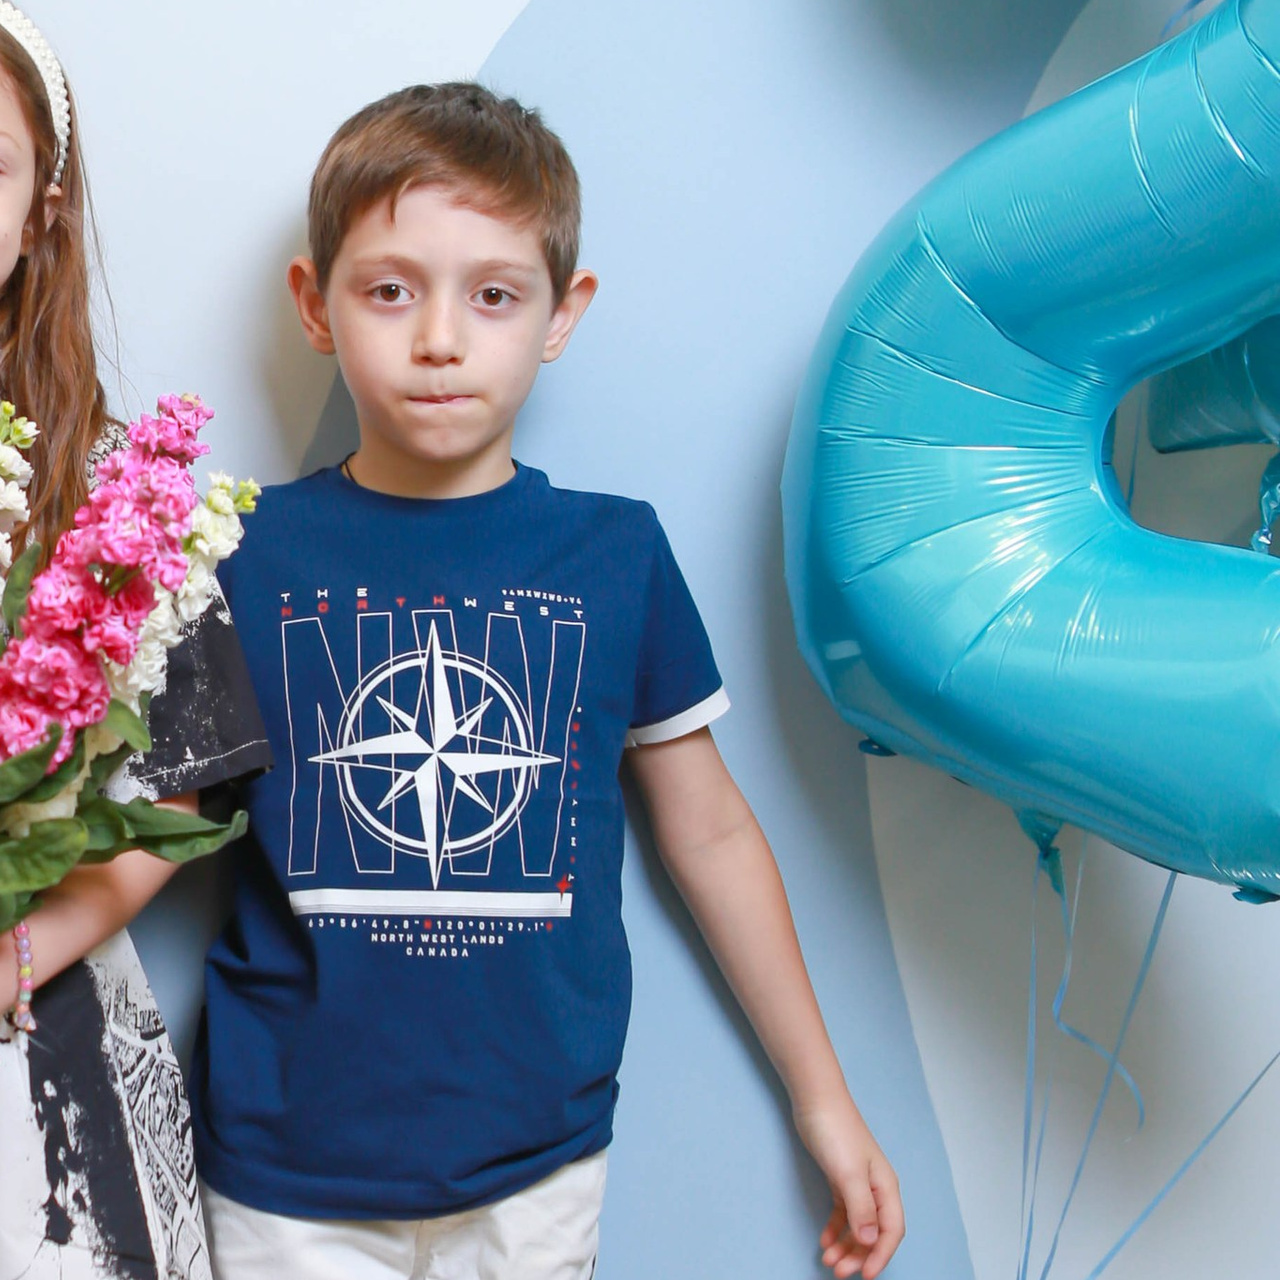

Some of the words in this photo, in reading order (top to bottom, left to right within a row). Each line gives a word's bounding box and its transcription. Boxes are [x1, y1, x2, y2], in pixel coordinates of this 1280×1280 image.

[280, 587, 368, 603] THE
[281, 594, 446, 617] NORTH
[463, 596, 584, 620] WEST
[370, 932, 414, 944] NORTH
[420, 932, 456, 945] WEST
[461, 933, 505, 945] LANDS
[405, 946, 470, 958] CANADA
